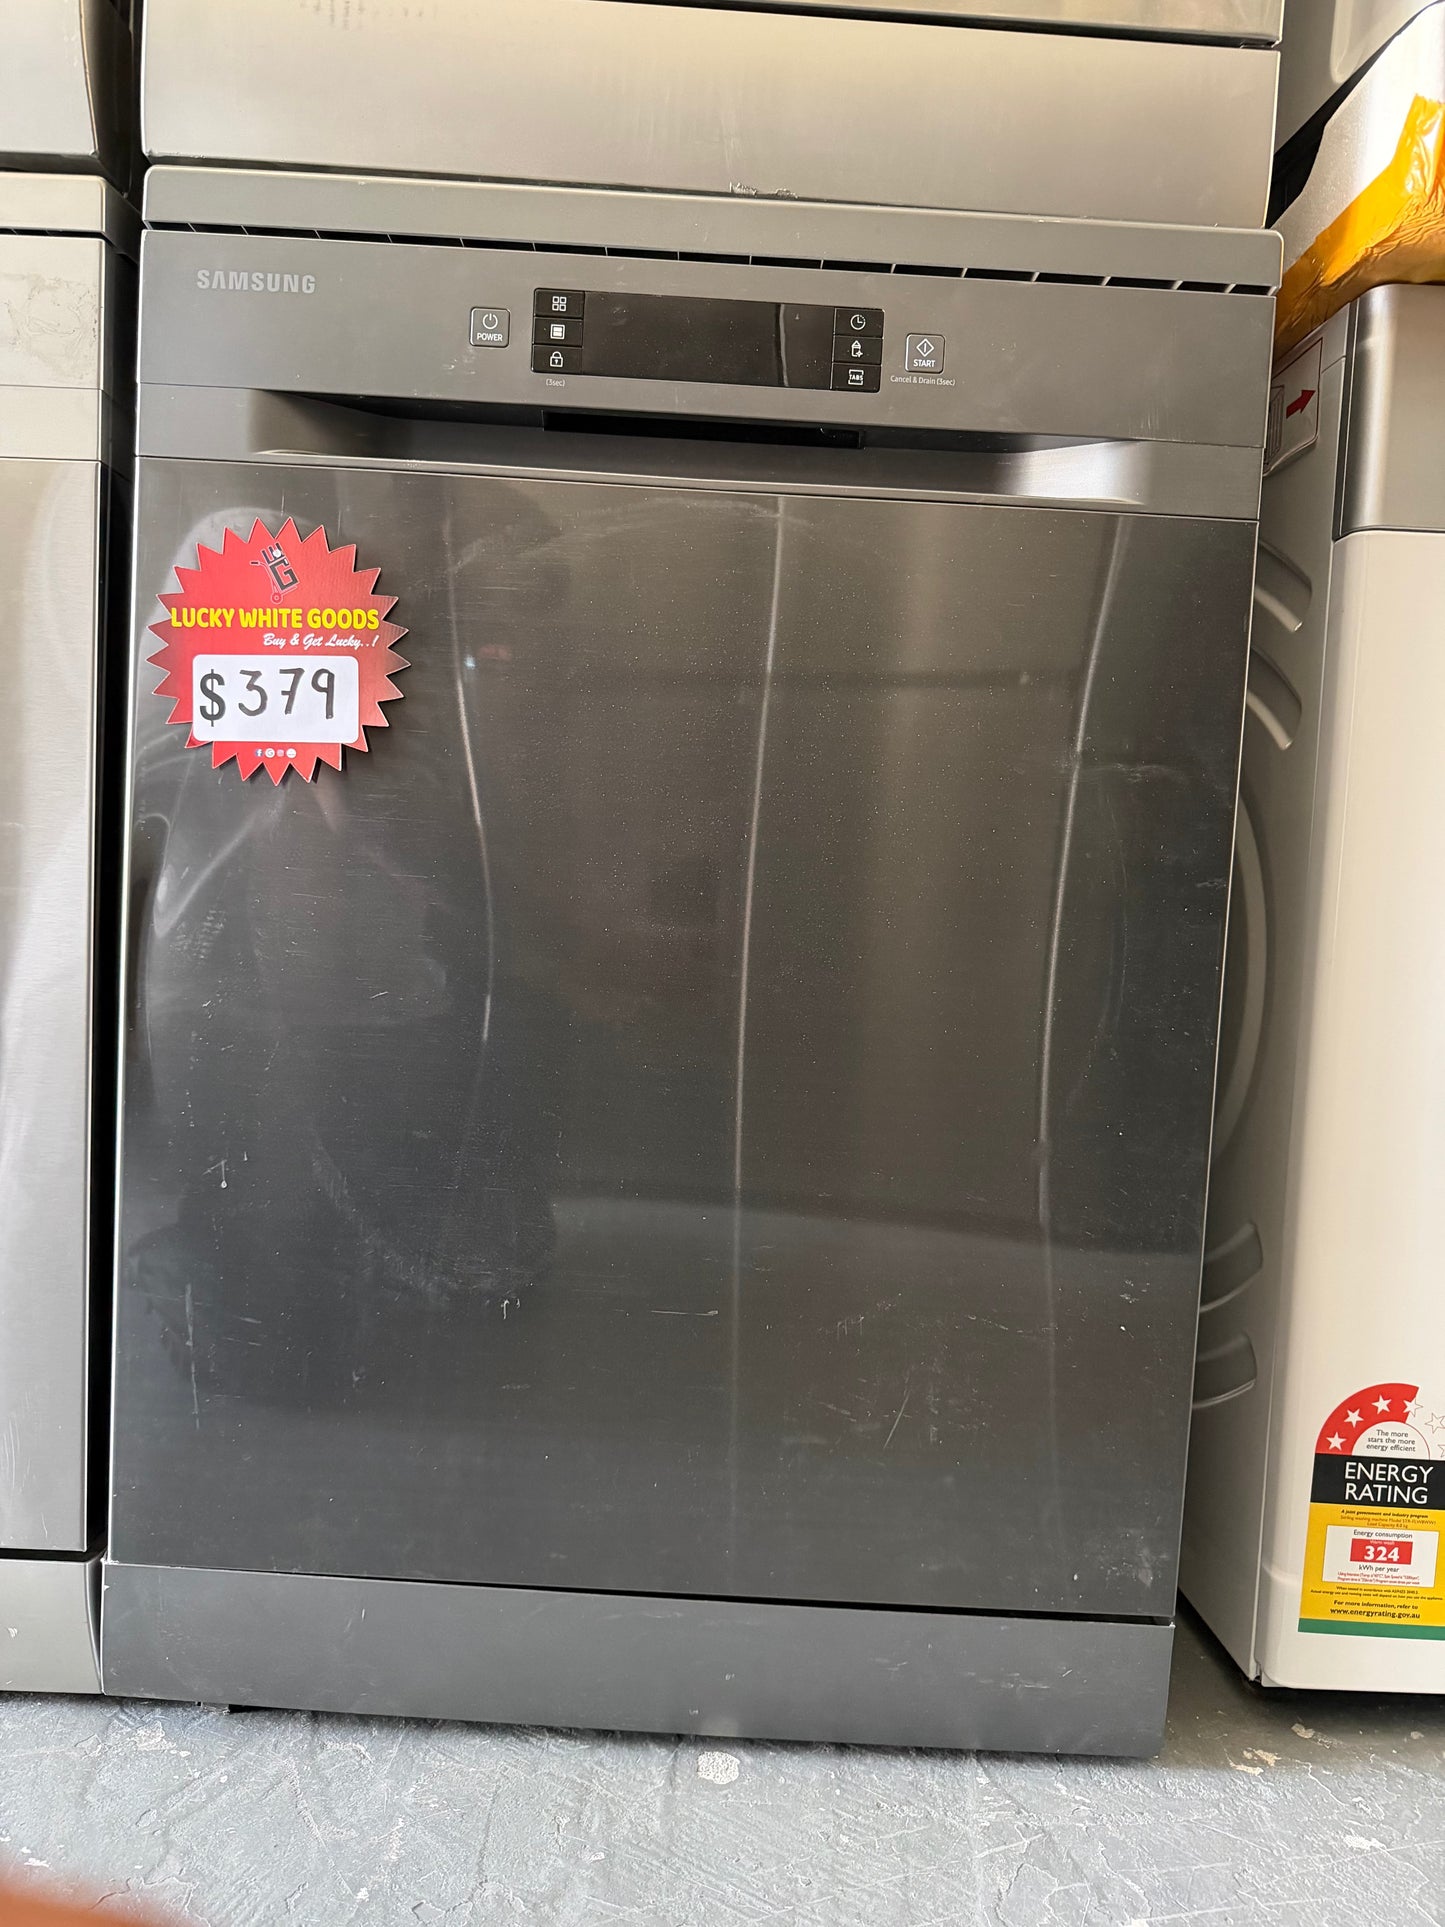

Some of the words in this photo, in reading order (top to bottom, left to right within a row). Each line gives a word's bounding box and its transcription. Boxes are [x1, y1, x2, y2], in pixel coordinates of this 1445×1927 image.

[197, 269, 316, 294] SAMSUNG
[476, 332, 503, 342] POWER
[913, 359, 936, 368] START
[545, 378, 566, 387] (3sec)
[890, 375, 912, 384] Cancel
[912, 376, 918, 384] &
[918, 376, 936, 385] Drain
[936, 377, 956, 386] (3sec)
[170, 607, 235, 628] LUCKY
[239, 608, 303, 629] WHITE
[307, 609, 380, 630] GOODS
[263, 633, 286, 648] Buy
[290, 634, 300, 646] &
[302, 634, 322, 649] Get
[199, 667, 335, 727] $379
[1376, 1429, 1389, 1437] The
[1366, 1444, 1388, 1452] energy
[1344, 1461, 1434, 1484] ENERGY
[1345, 1482, 1428, 1504] RATING
[1353, 1529, 1373, 1538] Energy
[1375, 1531, 1413, 1540] consumption
[1364, 1545, 1400, 1562] 324
[1330, 1608, 1420, 1619] www.energyrating.gov.au
